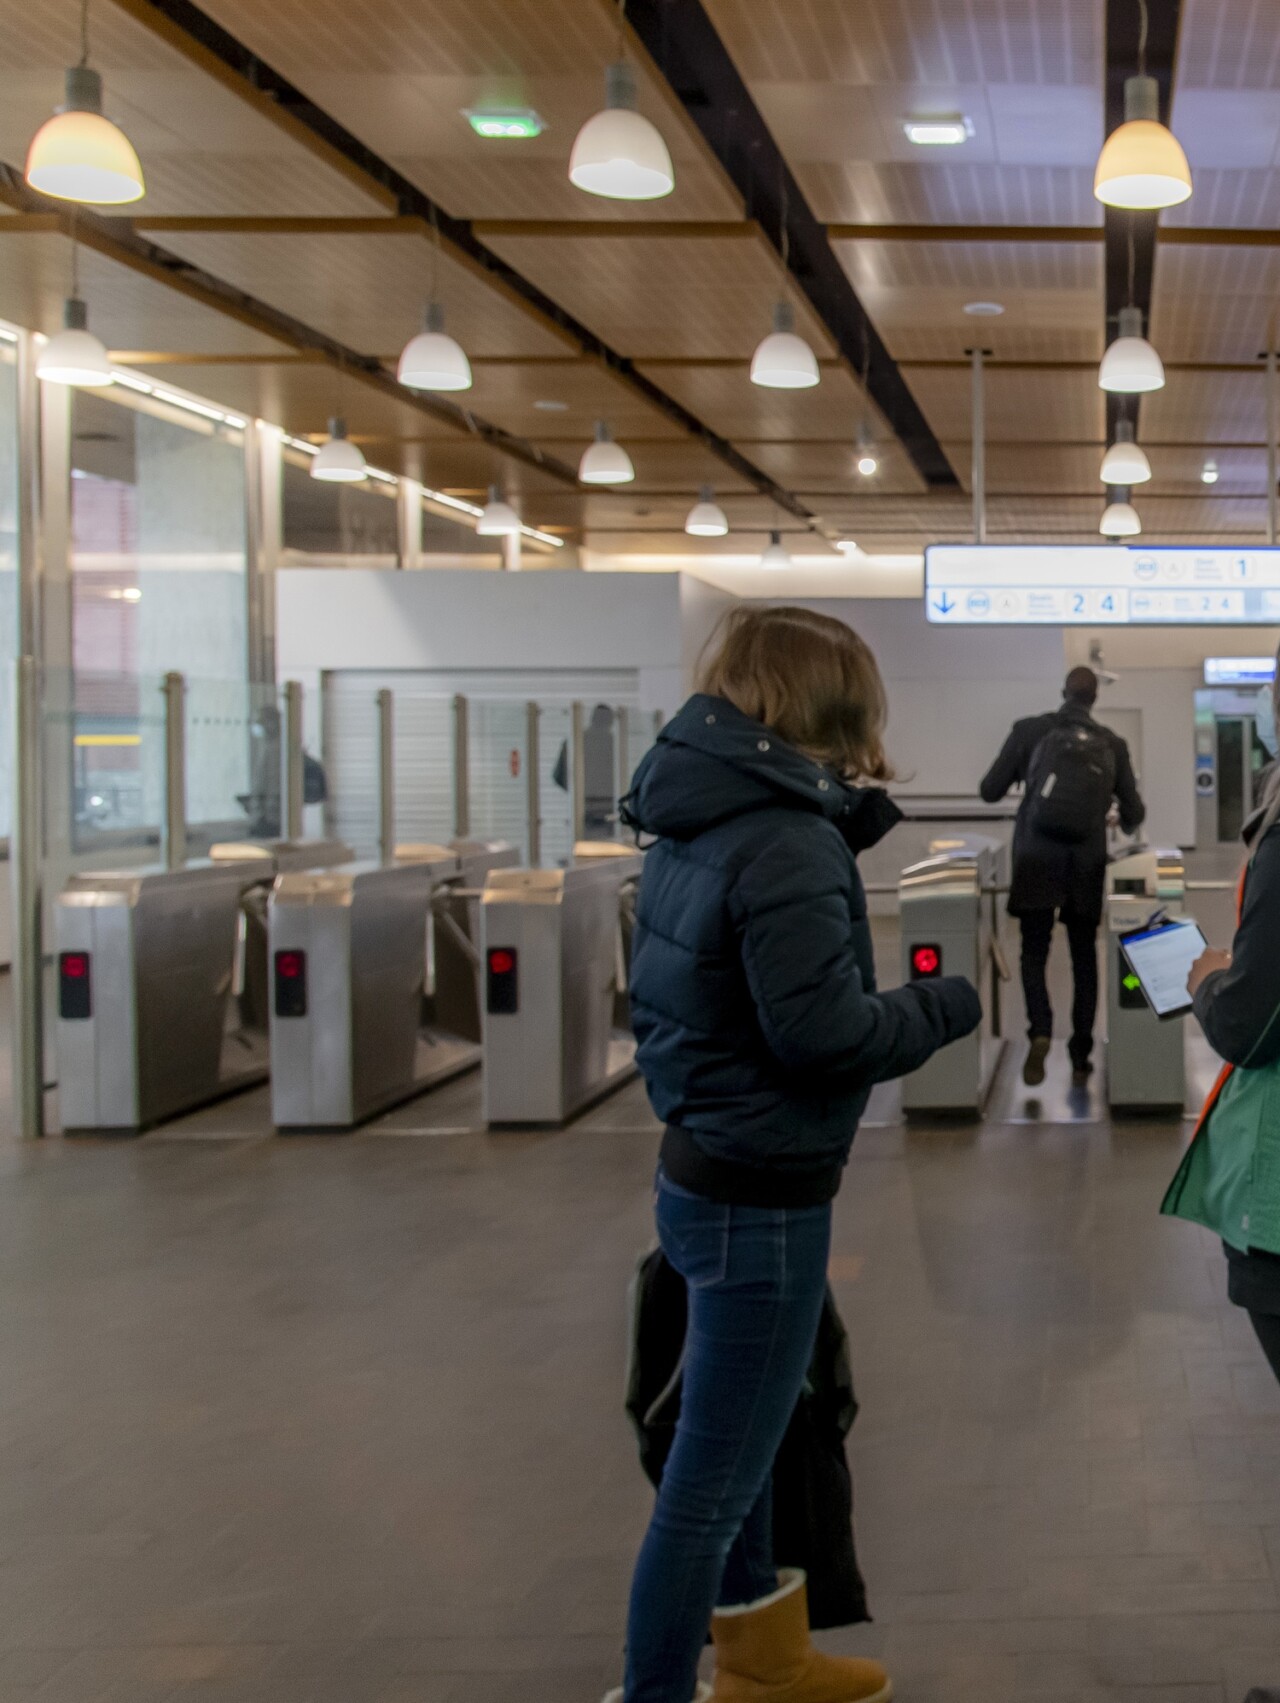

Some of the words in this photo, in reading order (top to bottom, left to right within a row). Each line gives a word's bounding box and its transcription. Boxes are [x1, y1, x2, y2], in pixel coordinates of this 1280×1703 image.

[1237, 559, 1247, 577] 1
[1073, 594, 1085, 613] 2
[1101, 594, 1114, 612] 4
[1202, 597, 1210, 610] 2
[1221, 597, 1229, 609] 4
